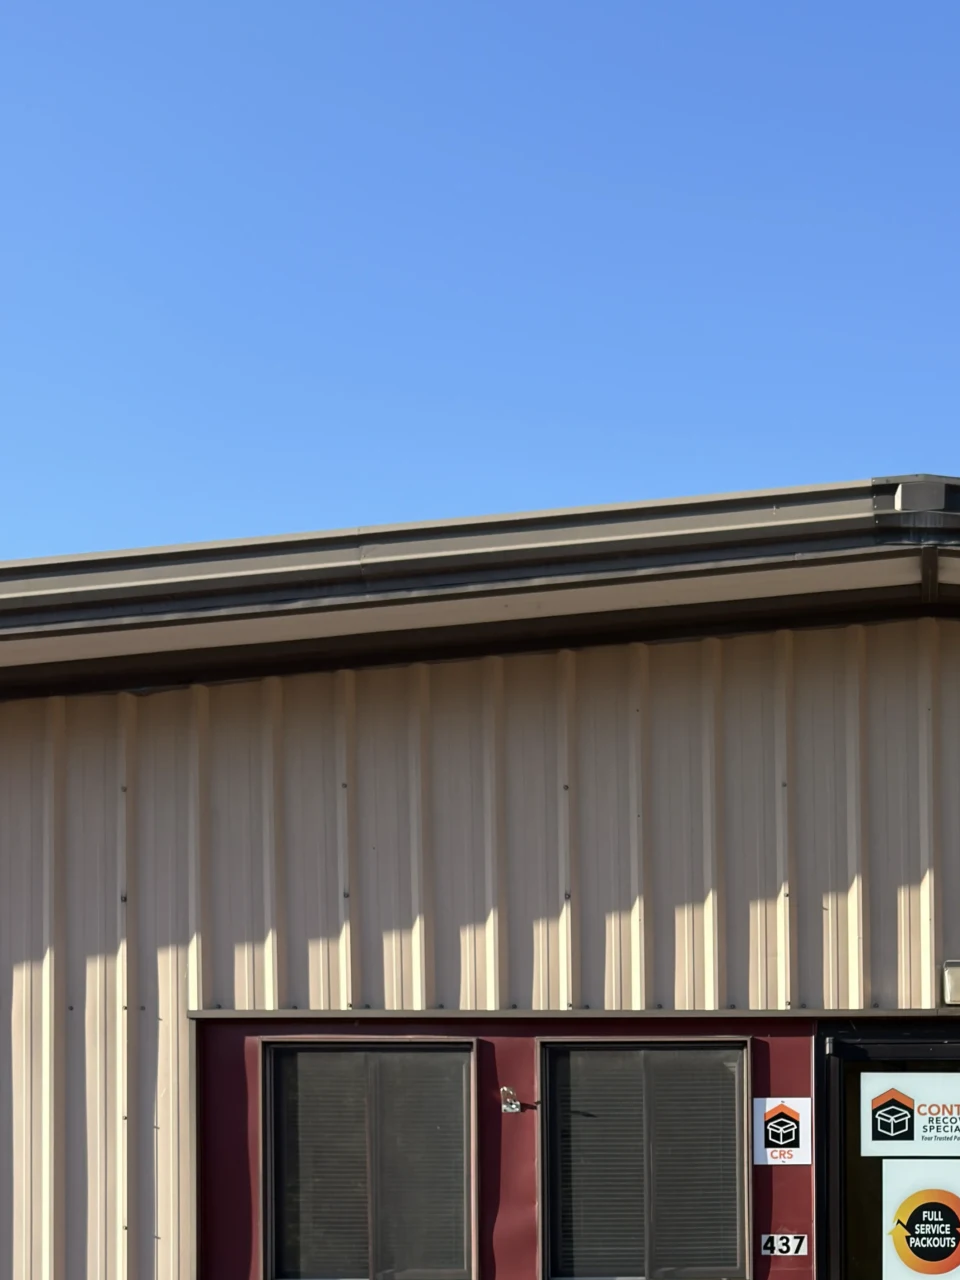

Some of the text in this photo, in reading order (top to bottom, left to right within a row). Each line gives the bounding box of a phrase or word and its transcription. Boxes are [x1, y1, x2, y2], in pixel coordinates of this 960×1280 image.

[770, 1149, 793, 1160] CRS
[922, 1210, 944, 1221] FULL
[914, 1223, 951, 1235] SERVICE
[762, 1235, 806, 1254] 437
[909, 1237, 956, 1248] PACKOUTS
